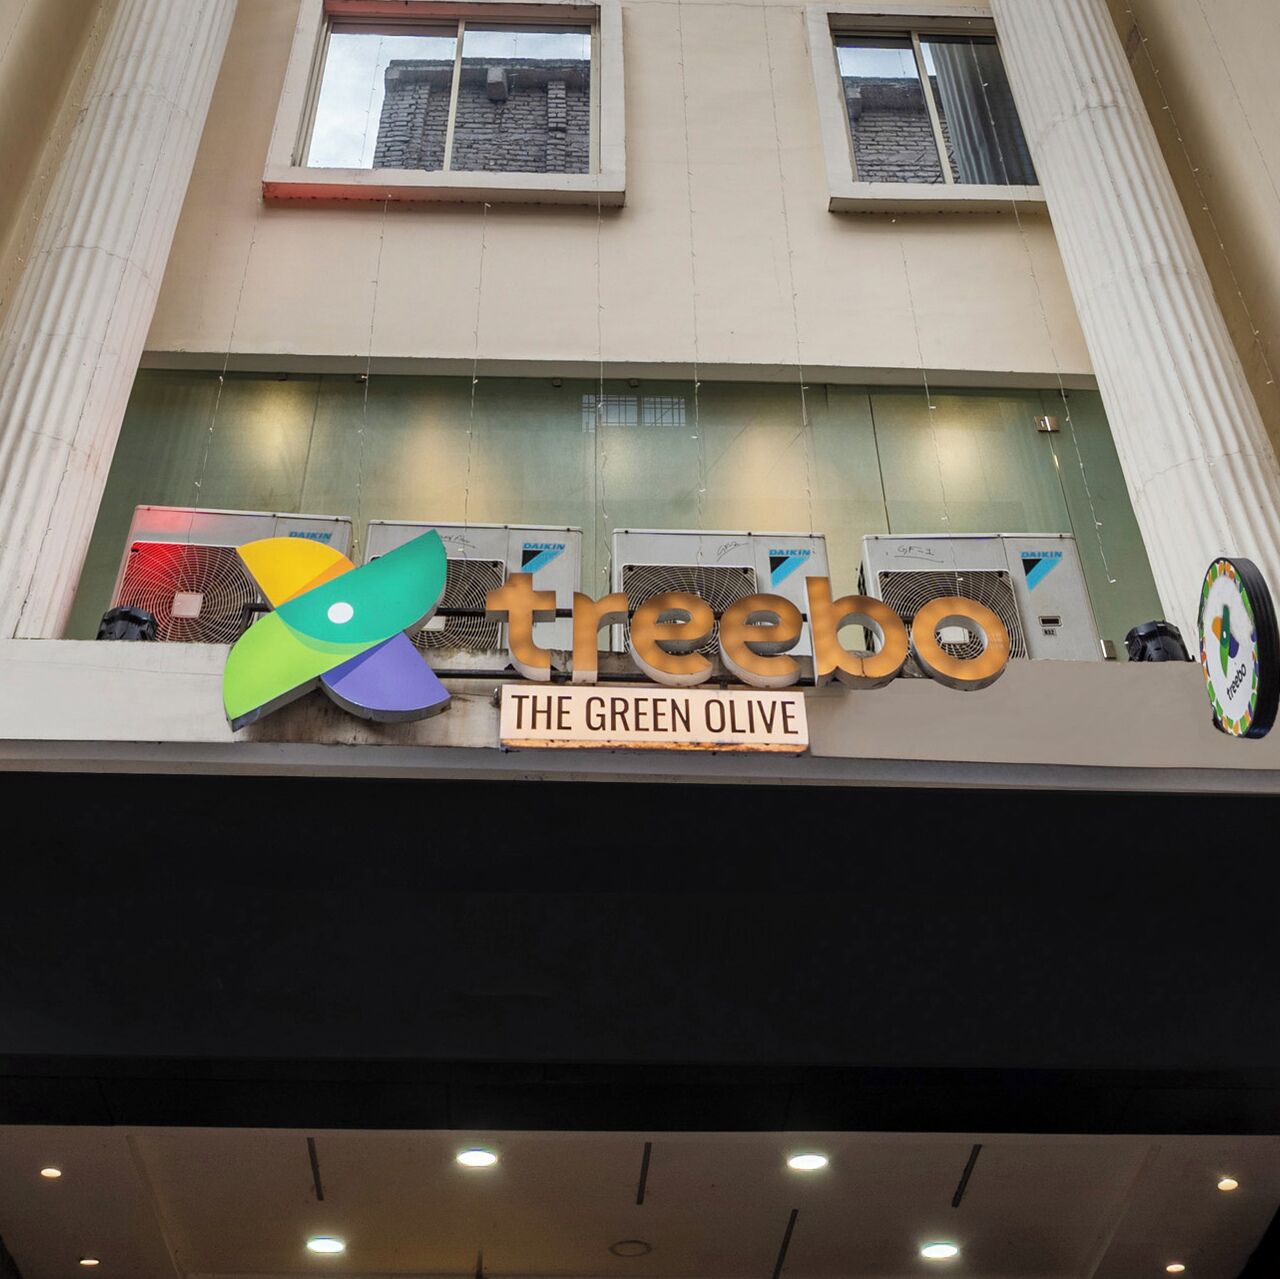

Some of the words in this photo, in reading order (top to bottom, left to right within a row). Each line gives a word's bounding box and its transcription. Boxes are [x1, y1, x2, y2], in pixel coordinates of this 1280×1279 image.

[288, 531, 333, 540] DAIKIN
[522, 542, 566, 550] DAIKIN
[769, 548, 811, 556] DAIKIN
[485, 576, 1008, 690] treebo
[1226, 663, 1247, 701] treebo
[511, 694, 572, 731] THE
[585, 695, 691, 733] GREEN
[705, 698, 800, 735] OLIVE
